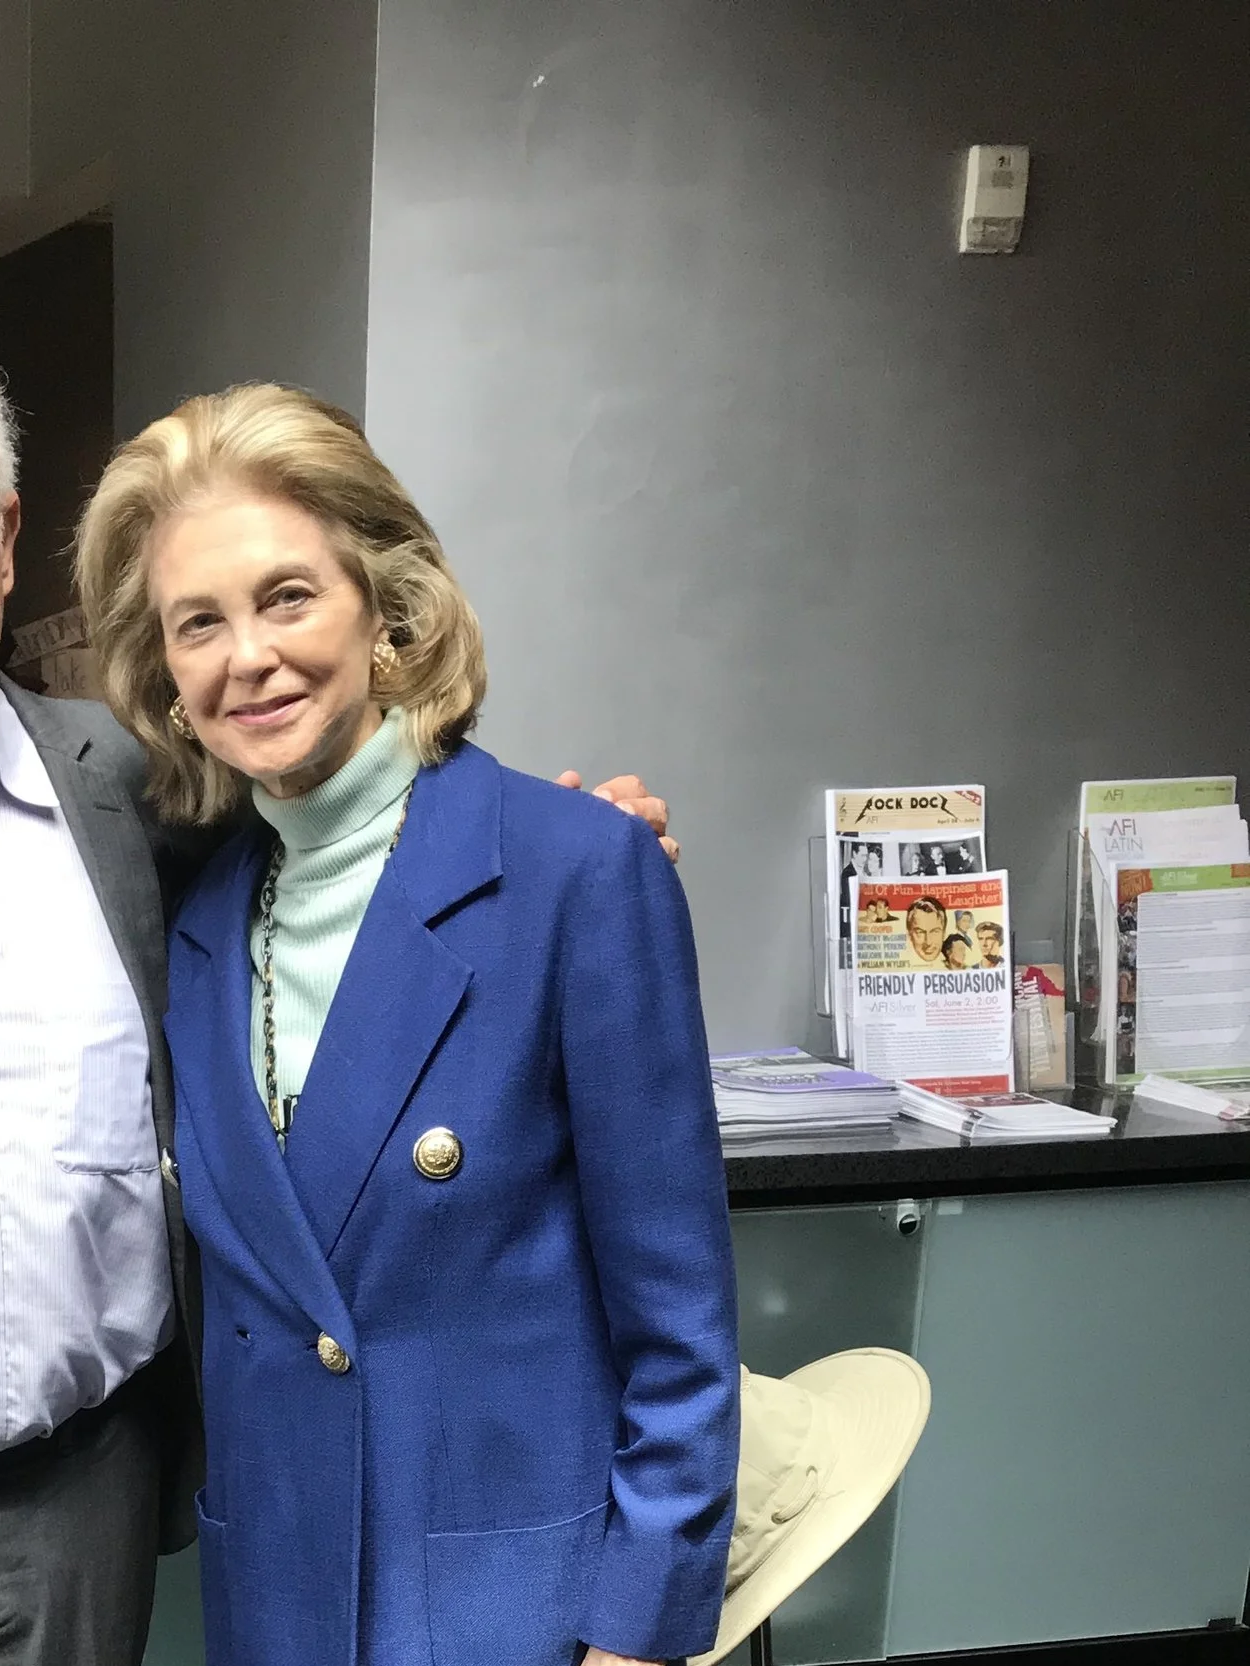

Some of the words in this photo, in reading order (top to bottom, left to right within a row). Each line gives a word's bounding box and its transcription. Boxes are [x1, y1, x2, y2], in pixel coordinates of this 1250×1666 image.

[1104, 788, 1124, 801] AFI
[1106, 818, 1137, 836] AFI
[1104, 836, 1144, 853] LATIN
[858, 974, 916, 997] FRIENDLY
[923, 970, 1006, 995] PERSUASION
[869, 1002, 888, 1013] AFI
[889, 1001, 917, 1013] Silver
[944, 997, 961, 1007] June
